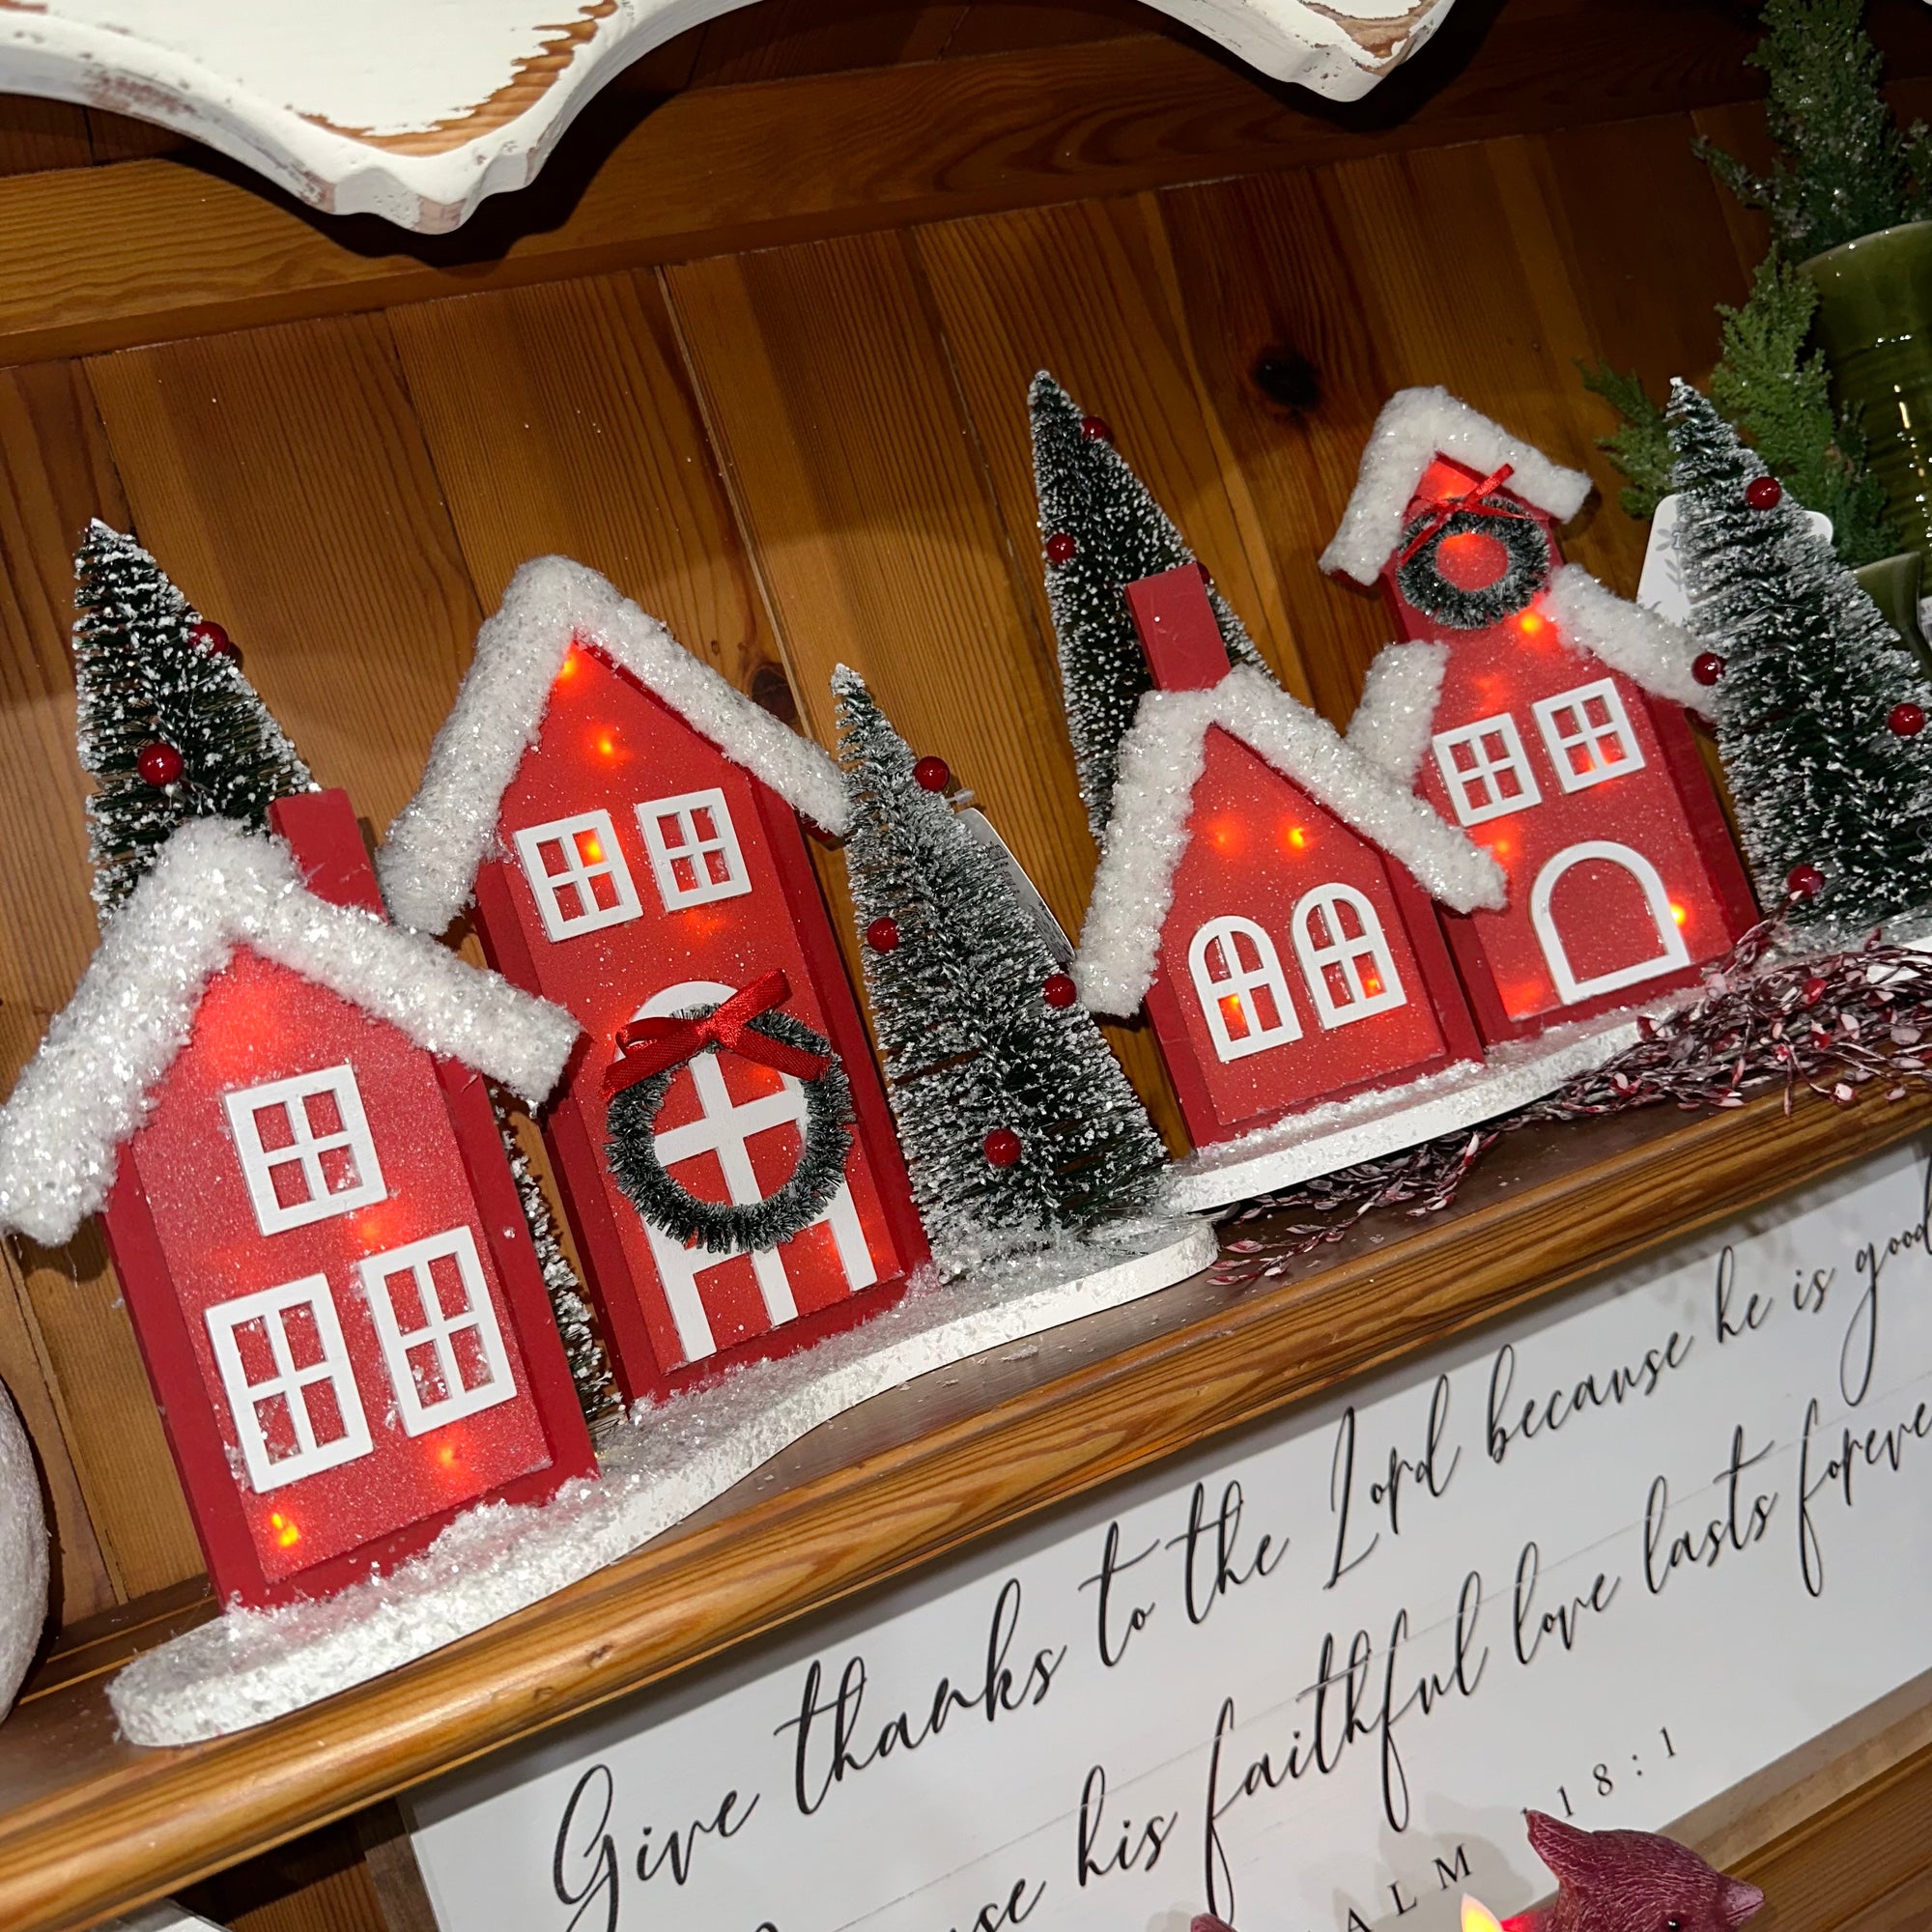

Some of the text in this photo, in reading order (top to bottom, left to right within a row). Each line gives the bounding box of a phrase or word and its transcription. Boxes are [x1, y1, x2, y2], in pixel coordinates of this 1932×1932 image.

[554, 1763, 759, 1932] Give
[774, 1577, 1067, 1814] thanks
[1078, 1520, 1160, 1666] to
[1165, 1480, 1289, 1624] the
[1324, 1374, 1460, 1590] Lord
[1487, 1331, 1693, 1463] because
[1717, 1246, 1772, 1344] he
[1794, 1266, 1835, 1314] is
[1077, 1399, 1932, 1925] his faithful love lasts foreve
[1307, 1726, 1676, 1932] ALM 18:1
